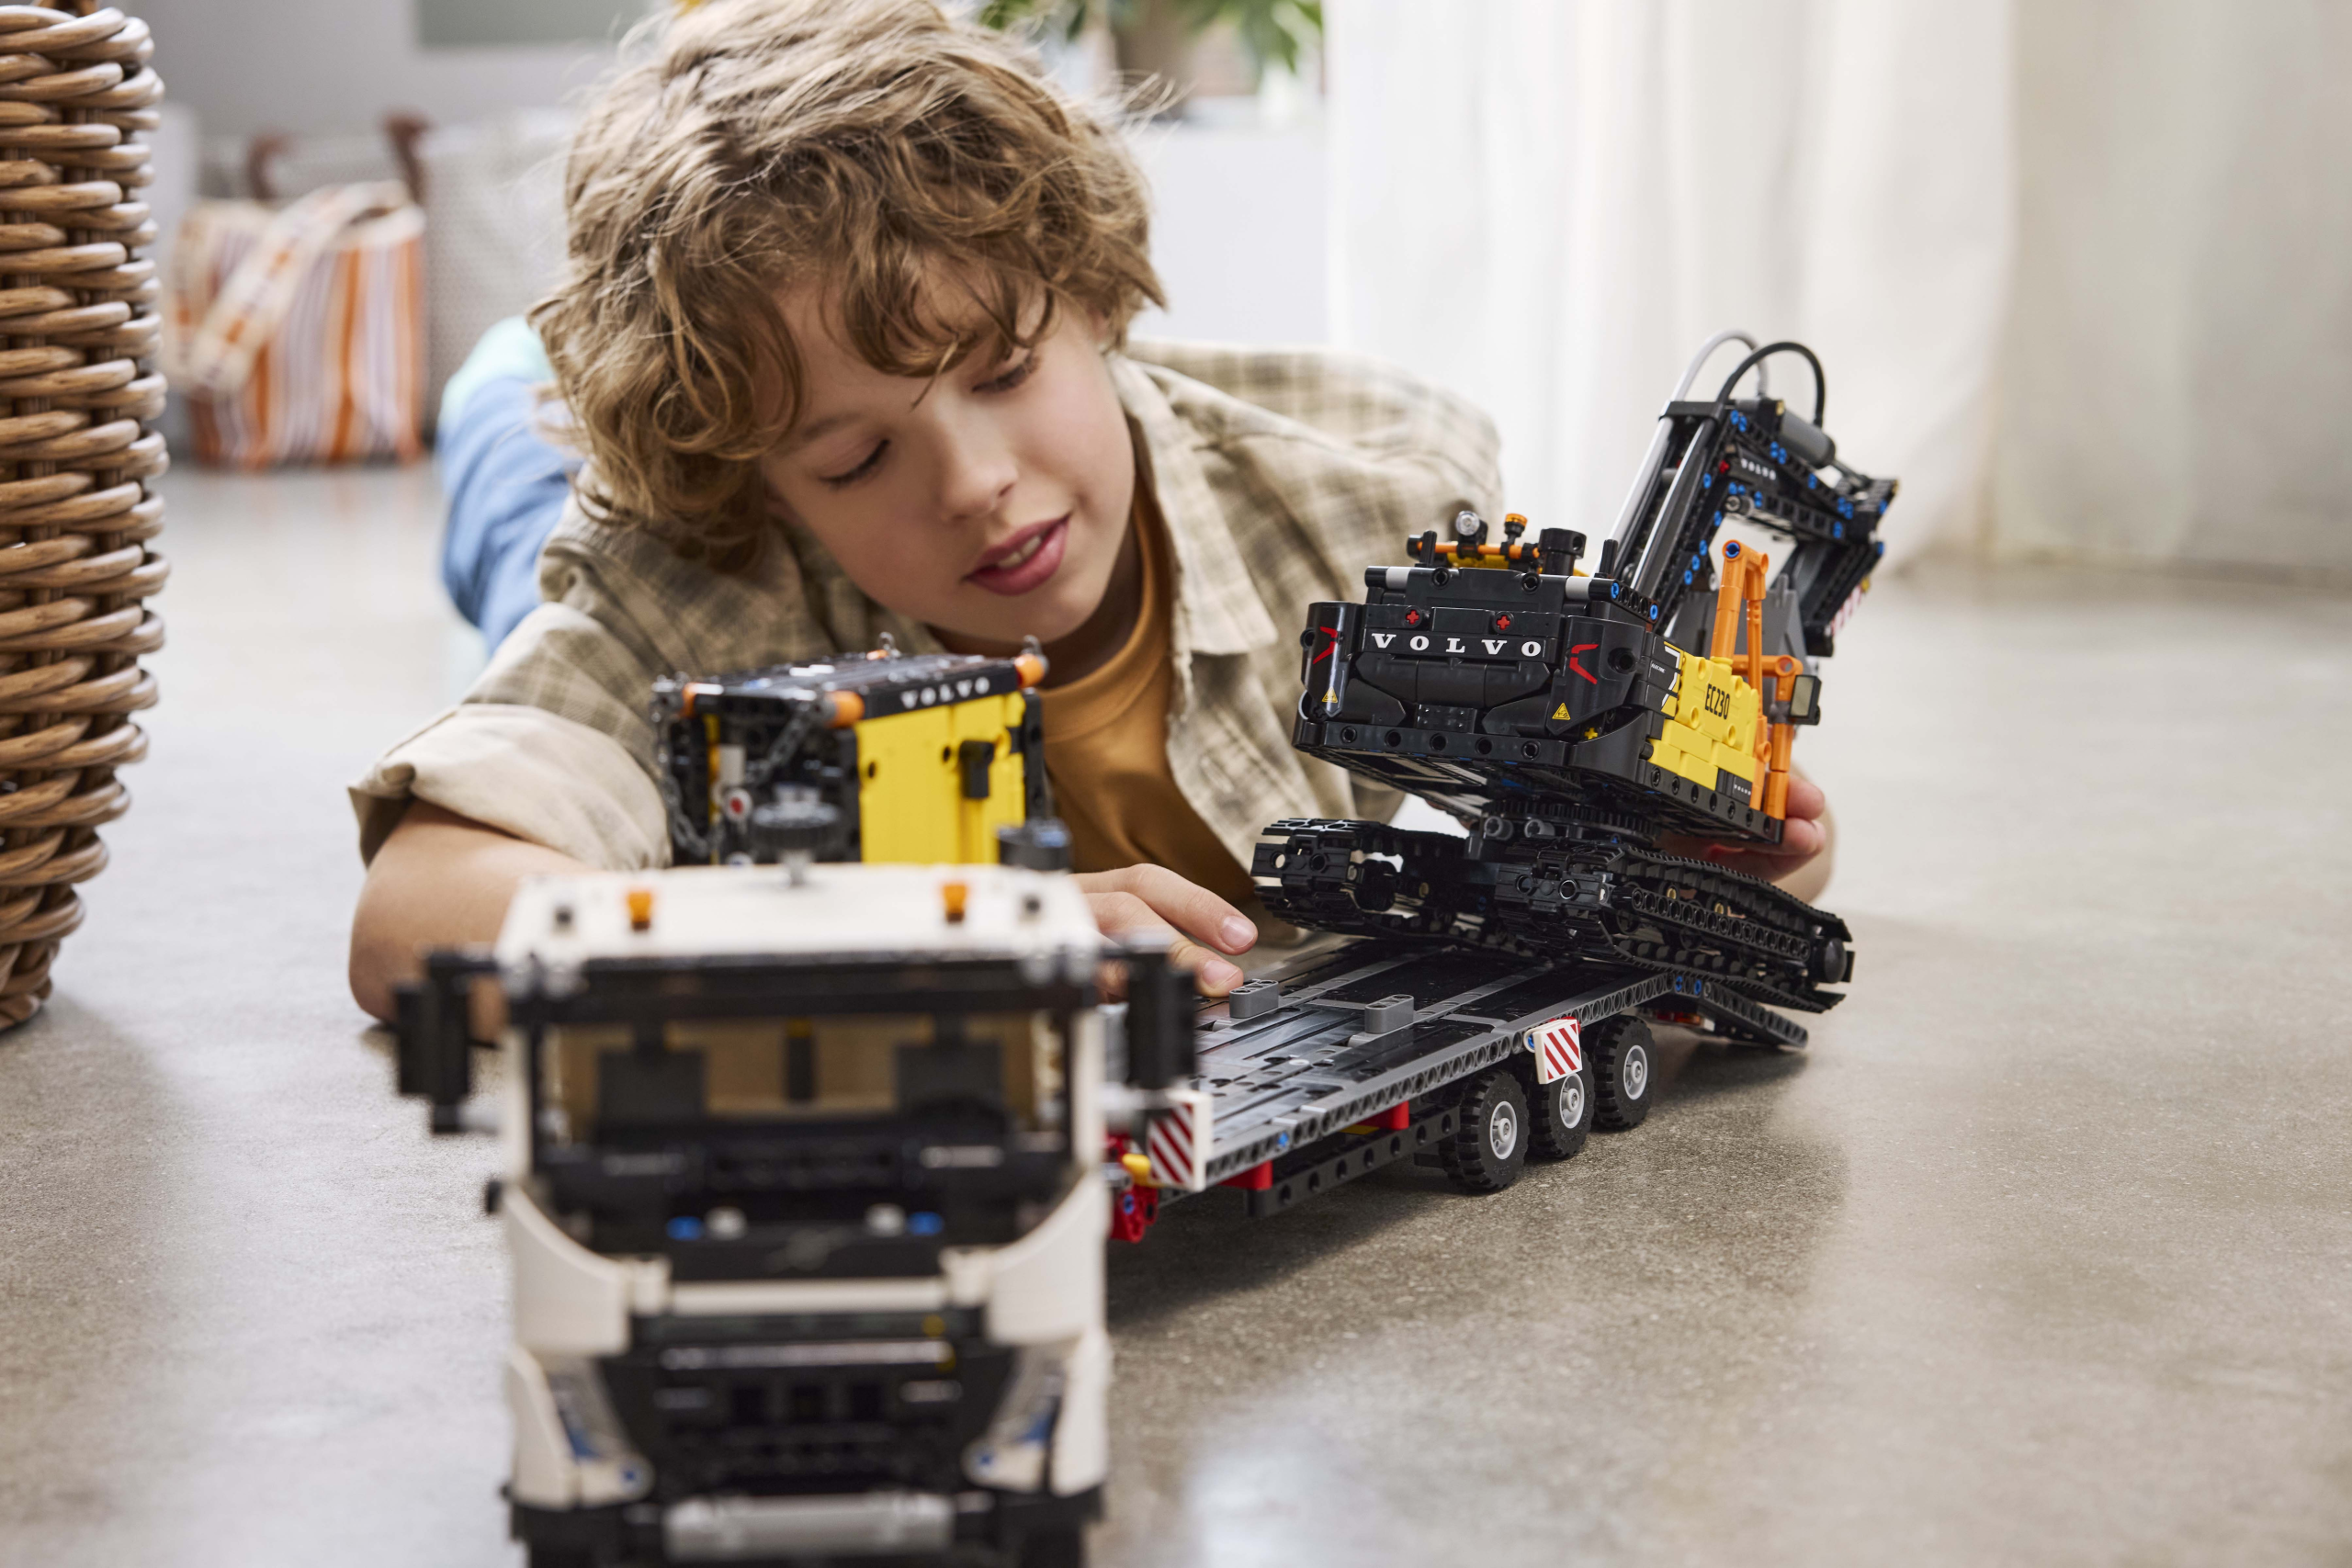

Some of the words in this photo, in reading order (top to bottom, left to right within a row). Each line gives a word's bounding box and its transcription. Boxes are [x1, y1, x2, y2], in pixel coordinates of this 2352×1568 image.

[1741, 458, 1776, 480] VOLVO
[1372, 633, 1542, 657] VOLVO
[900, 676, 989, 709] VOLVO
[1704, 683, 1730, 720] EC230
